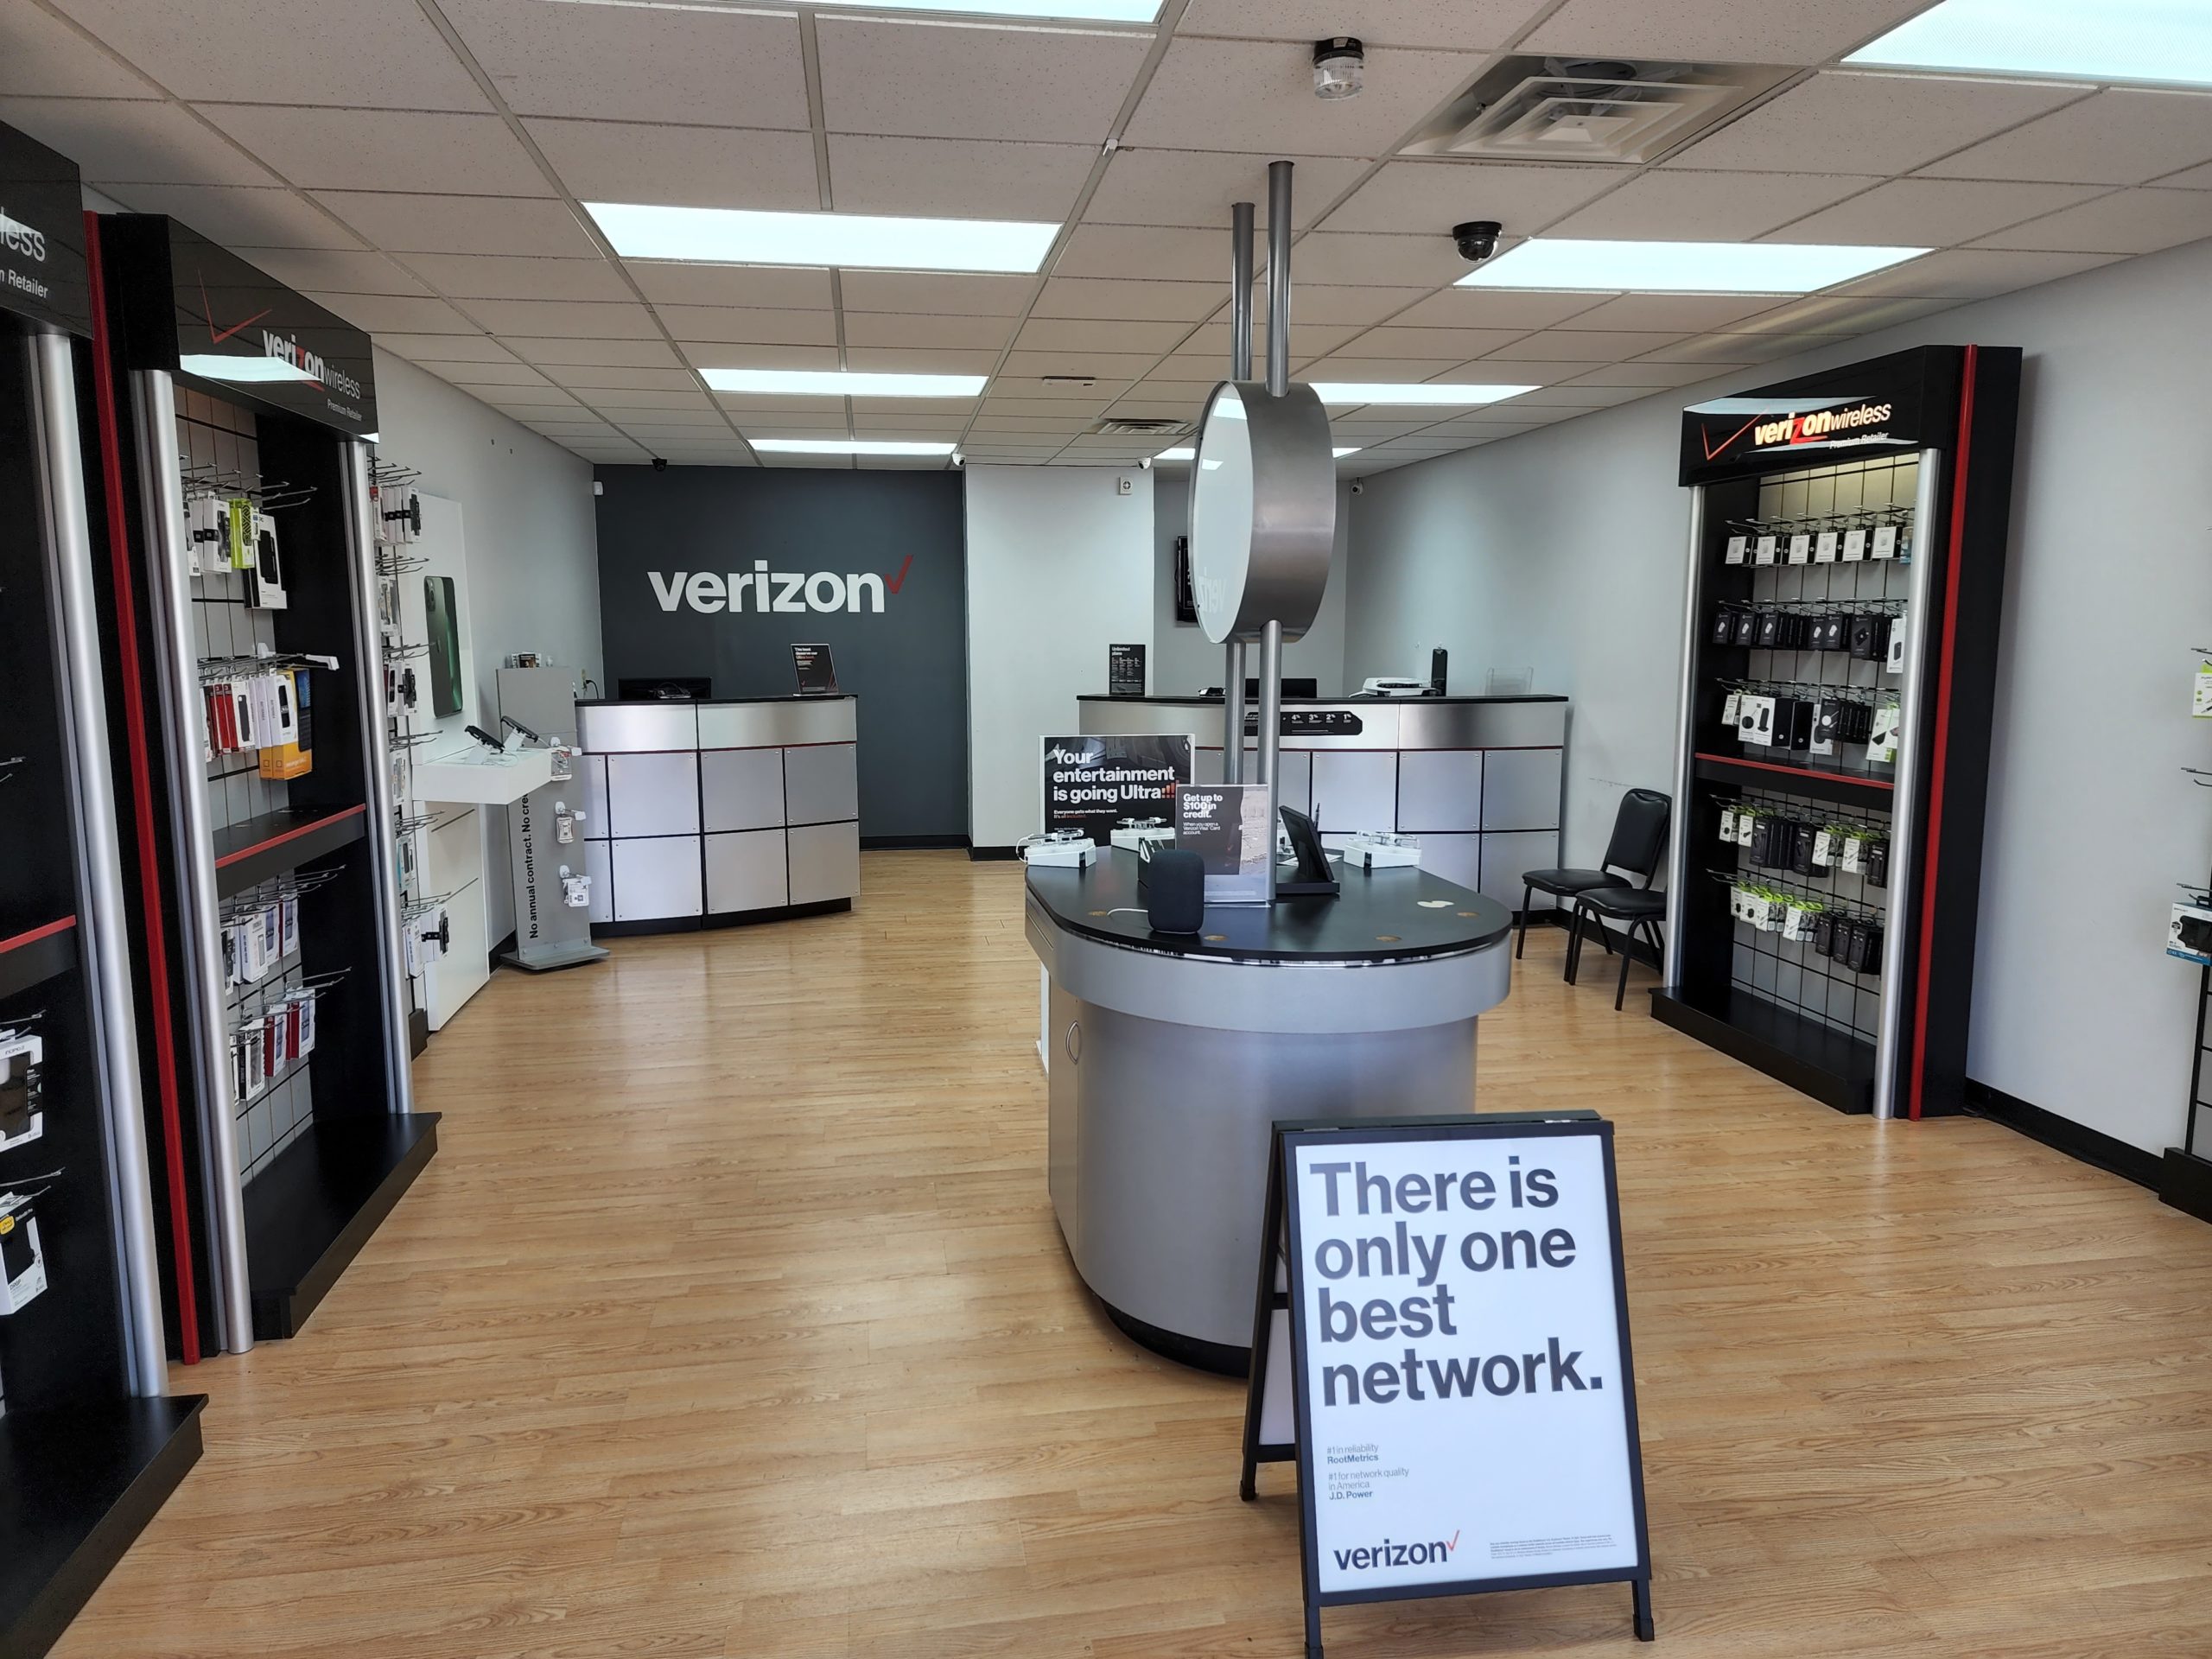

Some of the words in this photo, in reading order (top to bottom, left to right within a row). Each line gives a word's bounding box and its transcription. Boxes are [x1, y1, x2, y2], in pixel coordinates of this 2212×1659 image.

[8, 269, 48, 298] Retailer
[327, 398, 346, 415] Premium
[346, 406, 362, 422] Retailer
[1829, 437, 1861, 449] Premium
[1861, 431, 1890, 443] Retailer
[647, 559, 885, 613] verizon
[1053, 749, 1094, 765] Your
[1052, 766, 1175, 783] entertainment
[1053, 785, 1068, 802] is
[1070, 785, 1118, 804] going
[1183, 793, 1200, 802] Get
[1200, 795, 1212, 804] up
[1212, 793, 1224, 802] to
[1183, 801, 1208, 810] $100
[1208, 802, 1217, 810] in
[1183, 810, 1212, 818] credit.
[521, 817, 531, 833] No
[523, 835, 534, 884] contract.
[526, 885, 537, 922] annual
[530, 922, 539, 939] No
[1309, 1161, 1497, 1217] There
[1508, 1155, 1559, 1209] is
[1315, 1221, 1447, 1287] only
[1460, 1228, 1576, 1272] one
[1318, 1284, 1458, 1343] best
[1323, 1337, 1603, 1407] network.
[1327, 1446, 1335, 1455] #1
[1344, 1444, 1379, 1453] reliability
[1327, 1454, 1379, 1465] RootMetrics
[1328, 1472, 1337, 1481] #1
[1338, 1471, 1349, 1480] for
[1350, 1469, 1382, 1479] network
[1383, 1468, 1409, 1478] quality
[1337, 1481, 1370, 1491] America
[1345, 1491, 1373, 1499] Power
[1333, 1538, 1447, 1571] verizon
